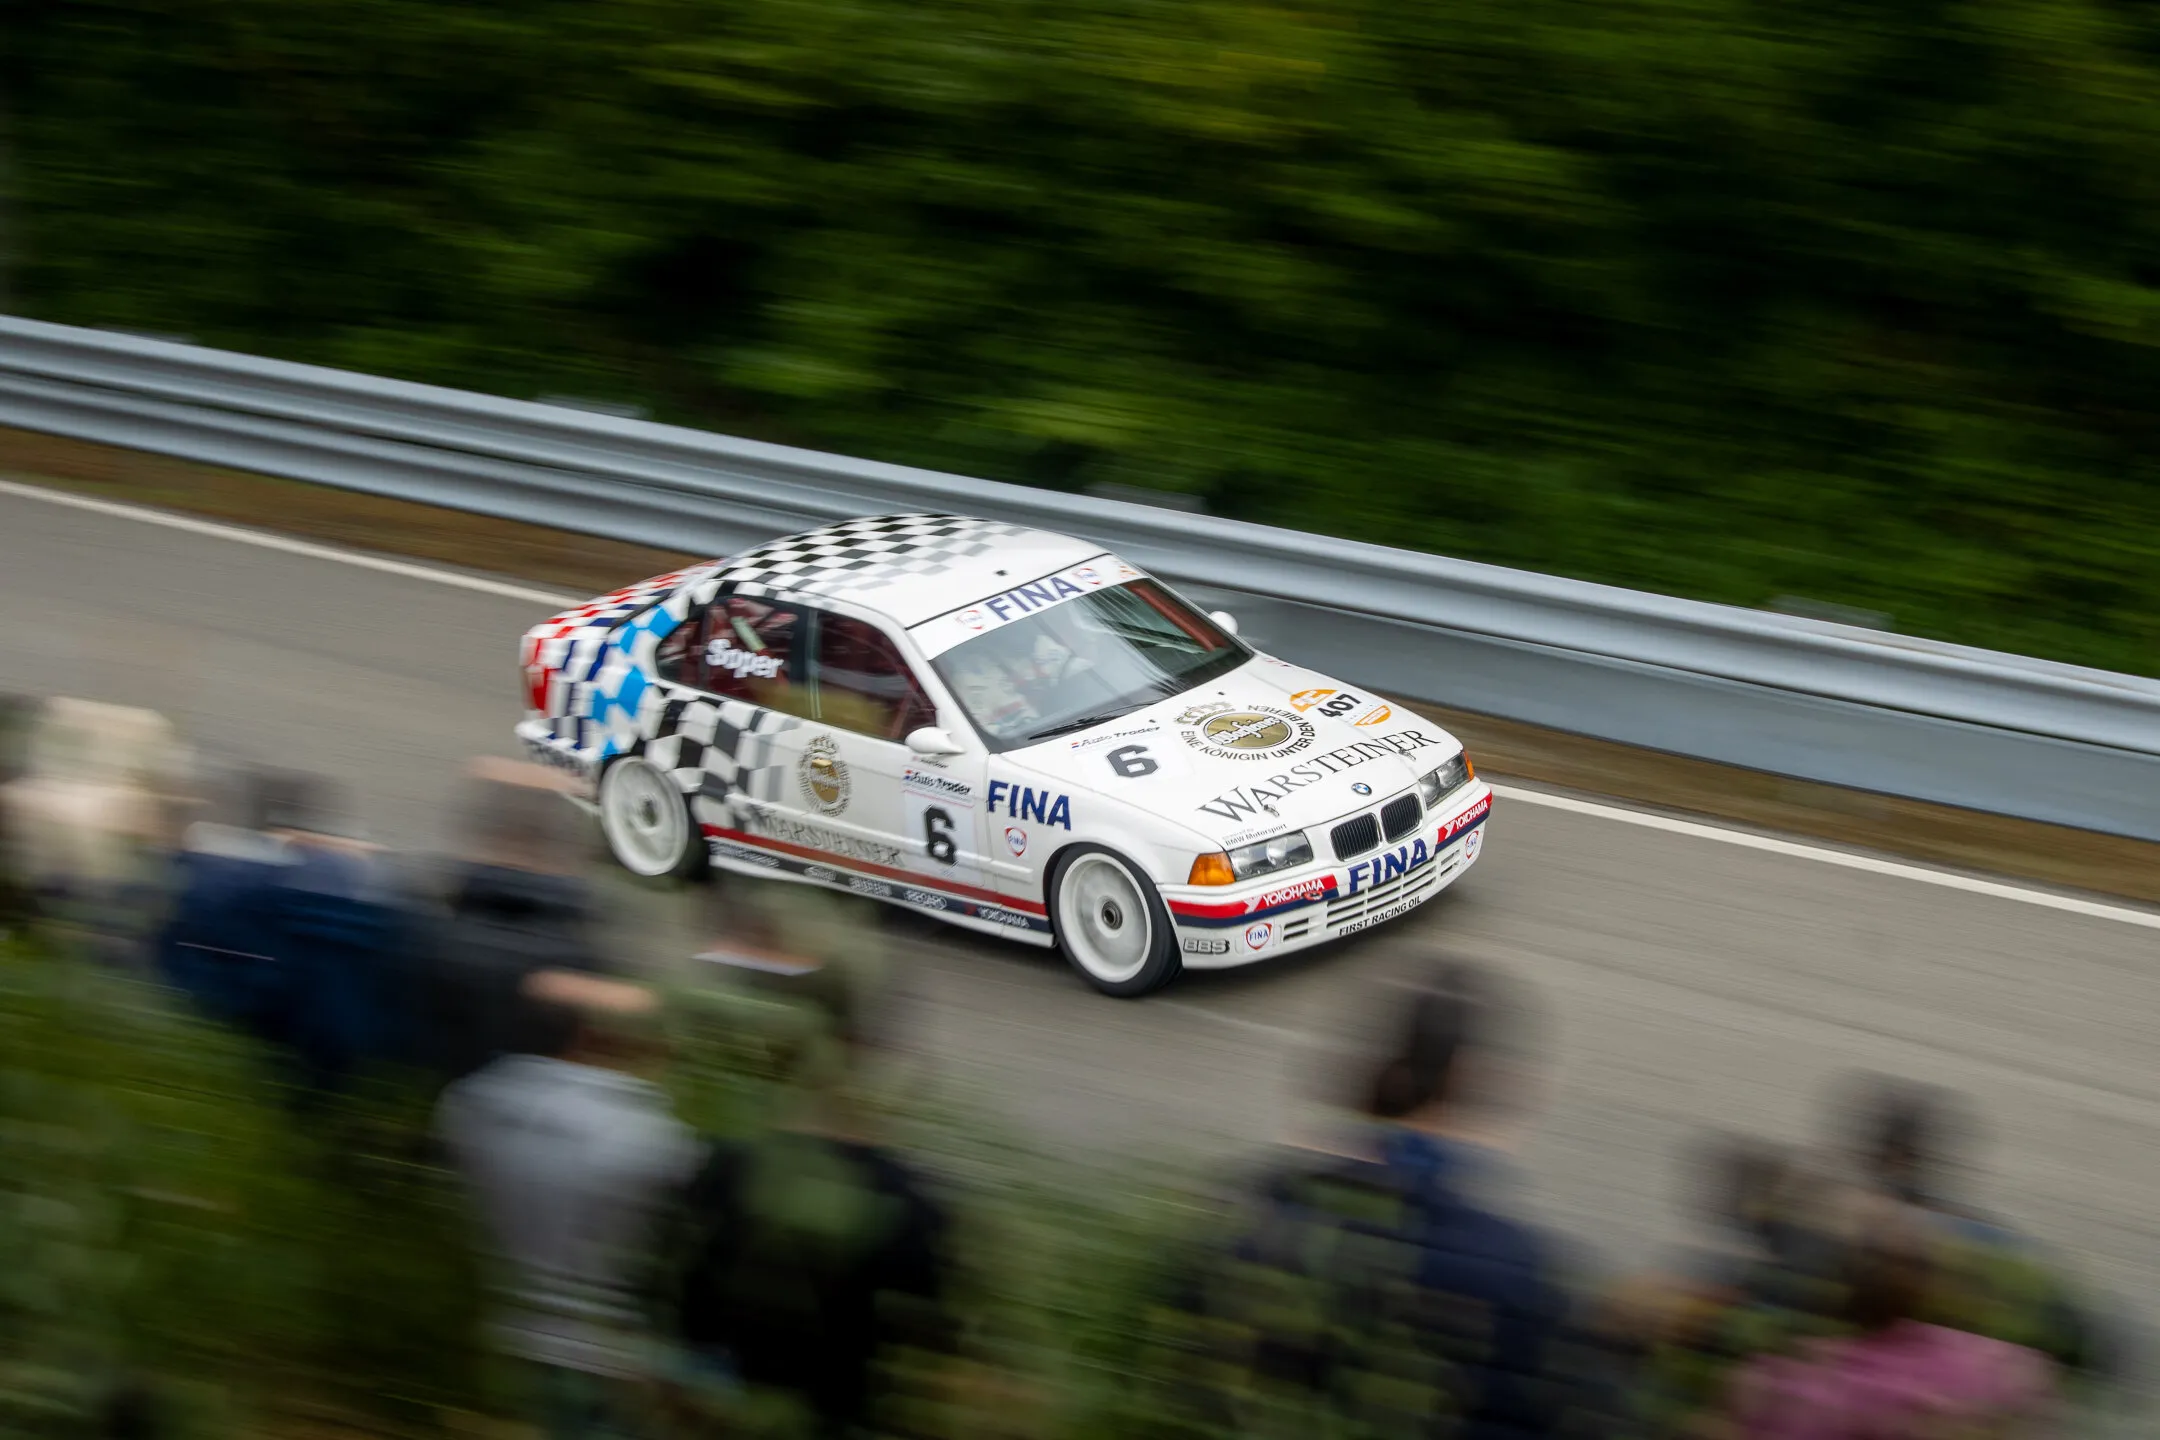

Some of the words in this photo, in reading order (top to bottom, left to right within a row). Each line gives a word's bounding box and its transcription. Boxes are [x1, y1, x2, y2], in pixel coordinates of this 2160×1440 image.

[985, 576, 1085, 621] FINA
[705, 638, 784, 678] Soper
[1247, 704, 1304, 722] BIEREN
[1317, 693, 1362, 717] 407
[1114, 726, 1160, 738] Trader
[1180, 730, 1204, 748] EINE
[1296, 721, 1316, 738] DEN
[1106, 744, 1159, 778] 6
[1199, 745, 1268, 761] KÖNIGIN
[1270, 738, 1313, 759] UNTER
[1198, 730, 1441, 823] WARSTEINER
[987, 779, 1072, 831] FINA
[1455, 799, 1488, 830] YOKOHAMA
[924, 805, 957, 866] 6
[1225, 835, 1245, 846] BMW
[1245, 823, 1287, 840] Motorsport
[1348, 838, 1428, 894] FINA
[1263, 879, 1325, 907] YOKOHAMA
[1338, 918, 1370, 936] FIRST
[1371, 903, 1408, 924] RACING
[1408, 895, 1422, 907] OIL
[1182, 937, 1231, 955] BBS
[1249, 930, 1269, 942] FINA
